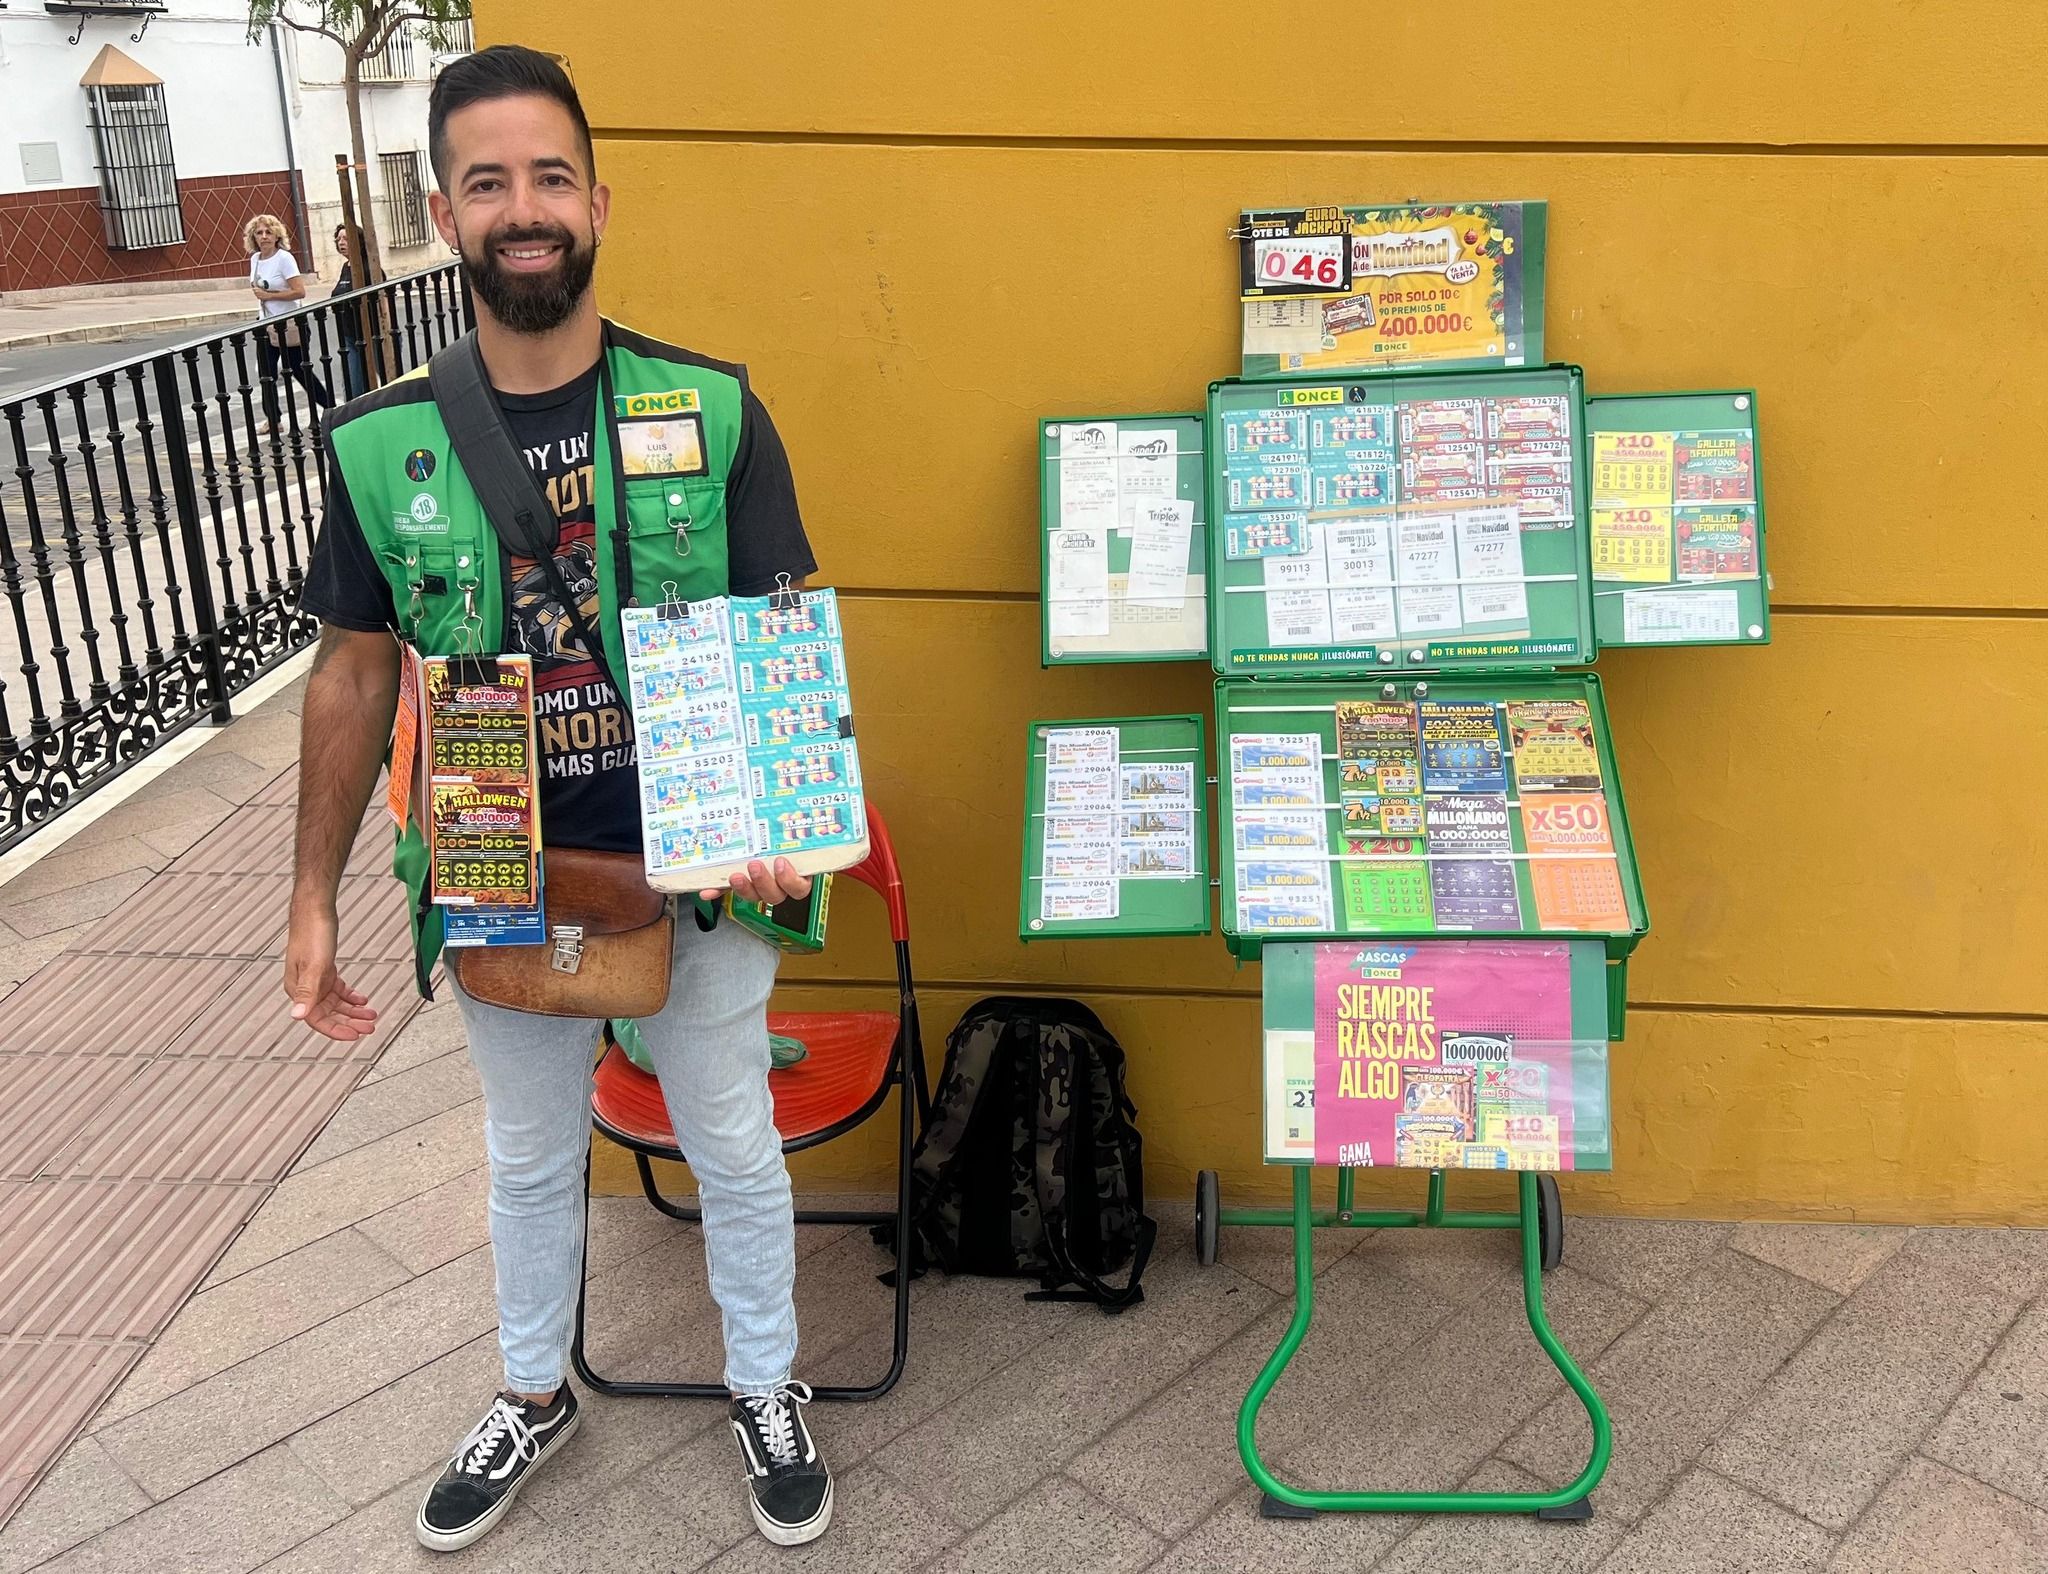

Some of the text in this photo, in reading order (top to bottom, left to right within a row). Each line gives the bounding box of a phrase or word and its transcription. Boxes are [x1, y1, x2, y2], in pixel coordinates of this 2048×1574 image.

[1305, 208, 1335, 222] EURO
[1275, 228, 1290, 237] DE
[1294, 219, 1350, 235] JACKPOT
[1372, 238, 1449, 269] Navidad
[1360, 262, 1370, 271] de
[1451, 270, 1475, 280] VENTA
[1379, 289, 1460, 304] POR SOLO 10€
[1378, 304, 1446, 316] 90 PREMIOS DE
[1379, 313, 1472, 336] 400.000€
[1384, 343, 1408, 351] ONCE
[1296, 391, 1339, 402] ONCE
[632, 393, 692, 412] ONCE
[1448, 444, 1474, 452] 12541
[1532, 442, 1560, 450] 77472
[1697, 439, 1736, 449] GALLETA
[1270, 454, 1297, 462] 24191
[1696, 448, 1736, 458] FORTUNA
[1534, 488, 1561, 496] 77472
[416, 498, 432, 516] +18
[1699, 514, 1738, 524] GALLETA
[1482, 522, 1510, 533] Navidad
[1699, 524, 1739, 533] FORTUNA
[1416, 531, 1444, 542] Navidad
[1474, 543, 1504, 552] 47277
[1408, 551, 1439, 560] 47277
[1280, 564, 1310, 574] 99113
[1344, 560, 1374, 570] 30013
[801, 596, 822, 604] 307
[794, 642, 828, 652] 02743
[1431, 643, 1574, 656] NO TE RINDAS NUNCA ¡ILUSIÓNATE!
[682, 652, 720, 665] 24180
[1233, 650, 1372, 662] NO TE RINDAS NUNCA ¡ILUSIÓNATE!
[586, 682, 616, 706] UN
[800, 692, 834, 702] 02743
[688, 700, 728, 714] 24180
[1353, 707, 1412, 715] HALLOWEEN
[1421, 707, 1494, 717] MILLONARIO
[1426, 720, 1494, 729] 500.000€
[1280, 736, 1310, 744] 93251
[806, 742, 840, 754] 02743
[547, 754, 594, 778] MAS
[694, 754, 734, 768] 85203
[1282, 776, 1312, 784] 93251
[452, 794, 527, 808] HALLOWEEN
[812, 794, 846, 805] 02743
[1448, 797, 1485, 808] Mega
[460, 813, 520, 823] 200.000€
[700, 806, 740, 820] 85203
[1426, 812, 1506, 824] MILLONARIO
[1429, 830, 1508, 840] 1.000.000€
[1550, 832, 1606, 843] 1.000.000€
[822, 881, 830, 920] ONCE
[1357, 951, 1406, 964] RASCAS
[1373, 970, 1398, 978] ONCE
[1338, 984, 1434, 1022] SIEMPRE
[1338, 1021, 1436, 1060] RASCAS
[1444, 1044, 1508, 1061] 1000000€
[1338, 1060, 1399, 1099] ALGO
[1339, 1142, 1372, 1163] GANA
